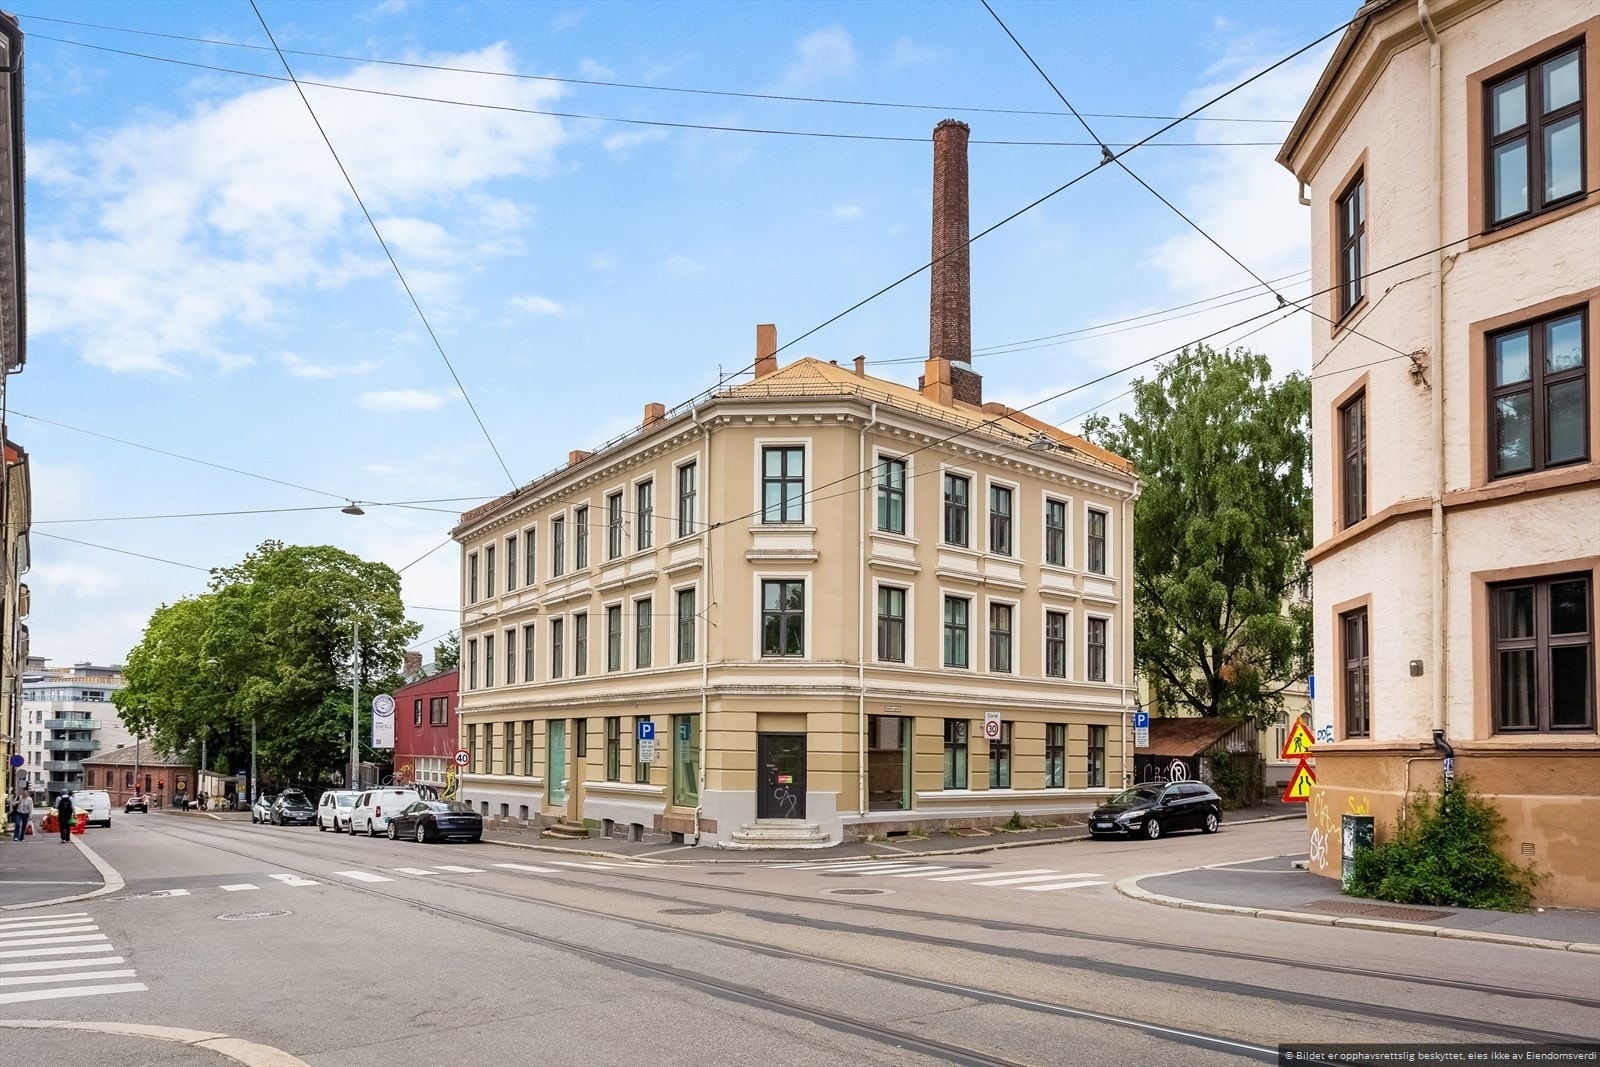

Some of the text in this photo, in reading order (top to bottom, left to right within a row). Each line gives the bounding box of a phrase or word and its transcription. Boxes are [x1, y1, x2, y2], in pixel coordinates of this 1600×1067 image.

[1138, 714, 1145, 726] P
[643, 724, 651, 738] P
[988, 725, 997, 733] 30
[456, 754, 468, 762] 40
